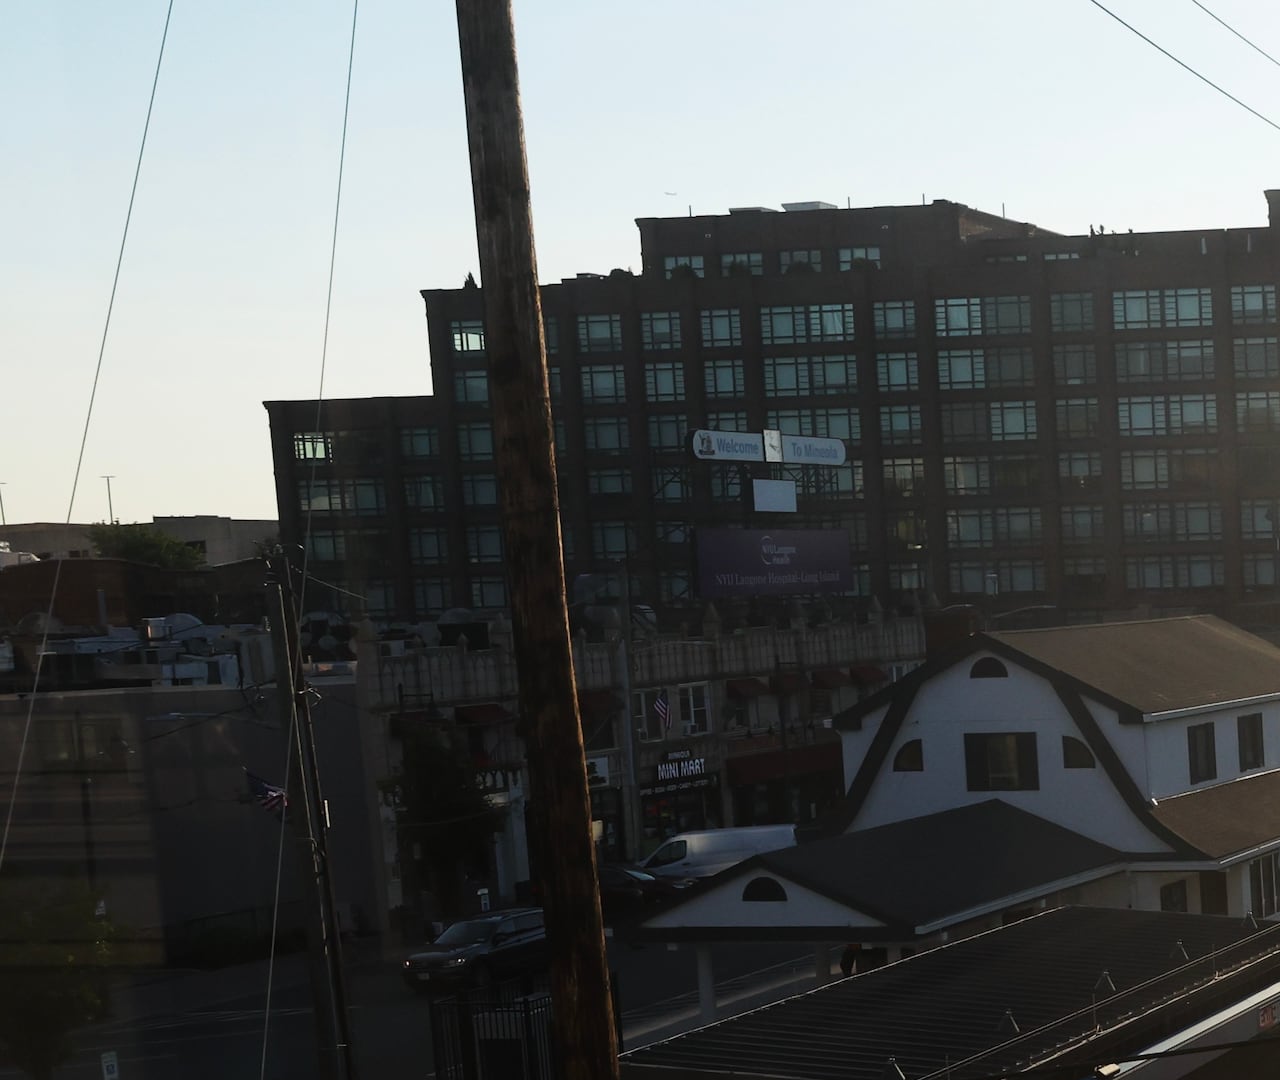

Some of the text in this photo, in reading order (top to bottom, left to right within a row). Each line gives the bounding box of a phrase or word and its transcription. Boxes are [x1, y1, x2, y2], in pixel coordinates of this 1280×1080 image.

[716, 437, 838, 458] Welcome To Mineola
[716, 574, 734, 586] NYU
[657, 758, 705, 781] MINI MART
